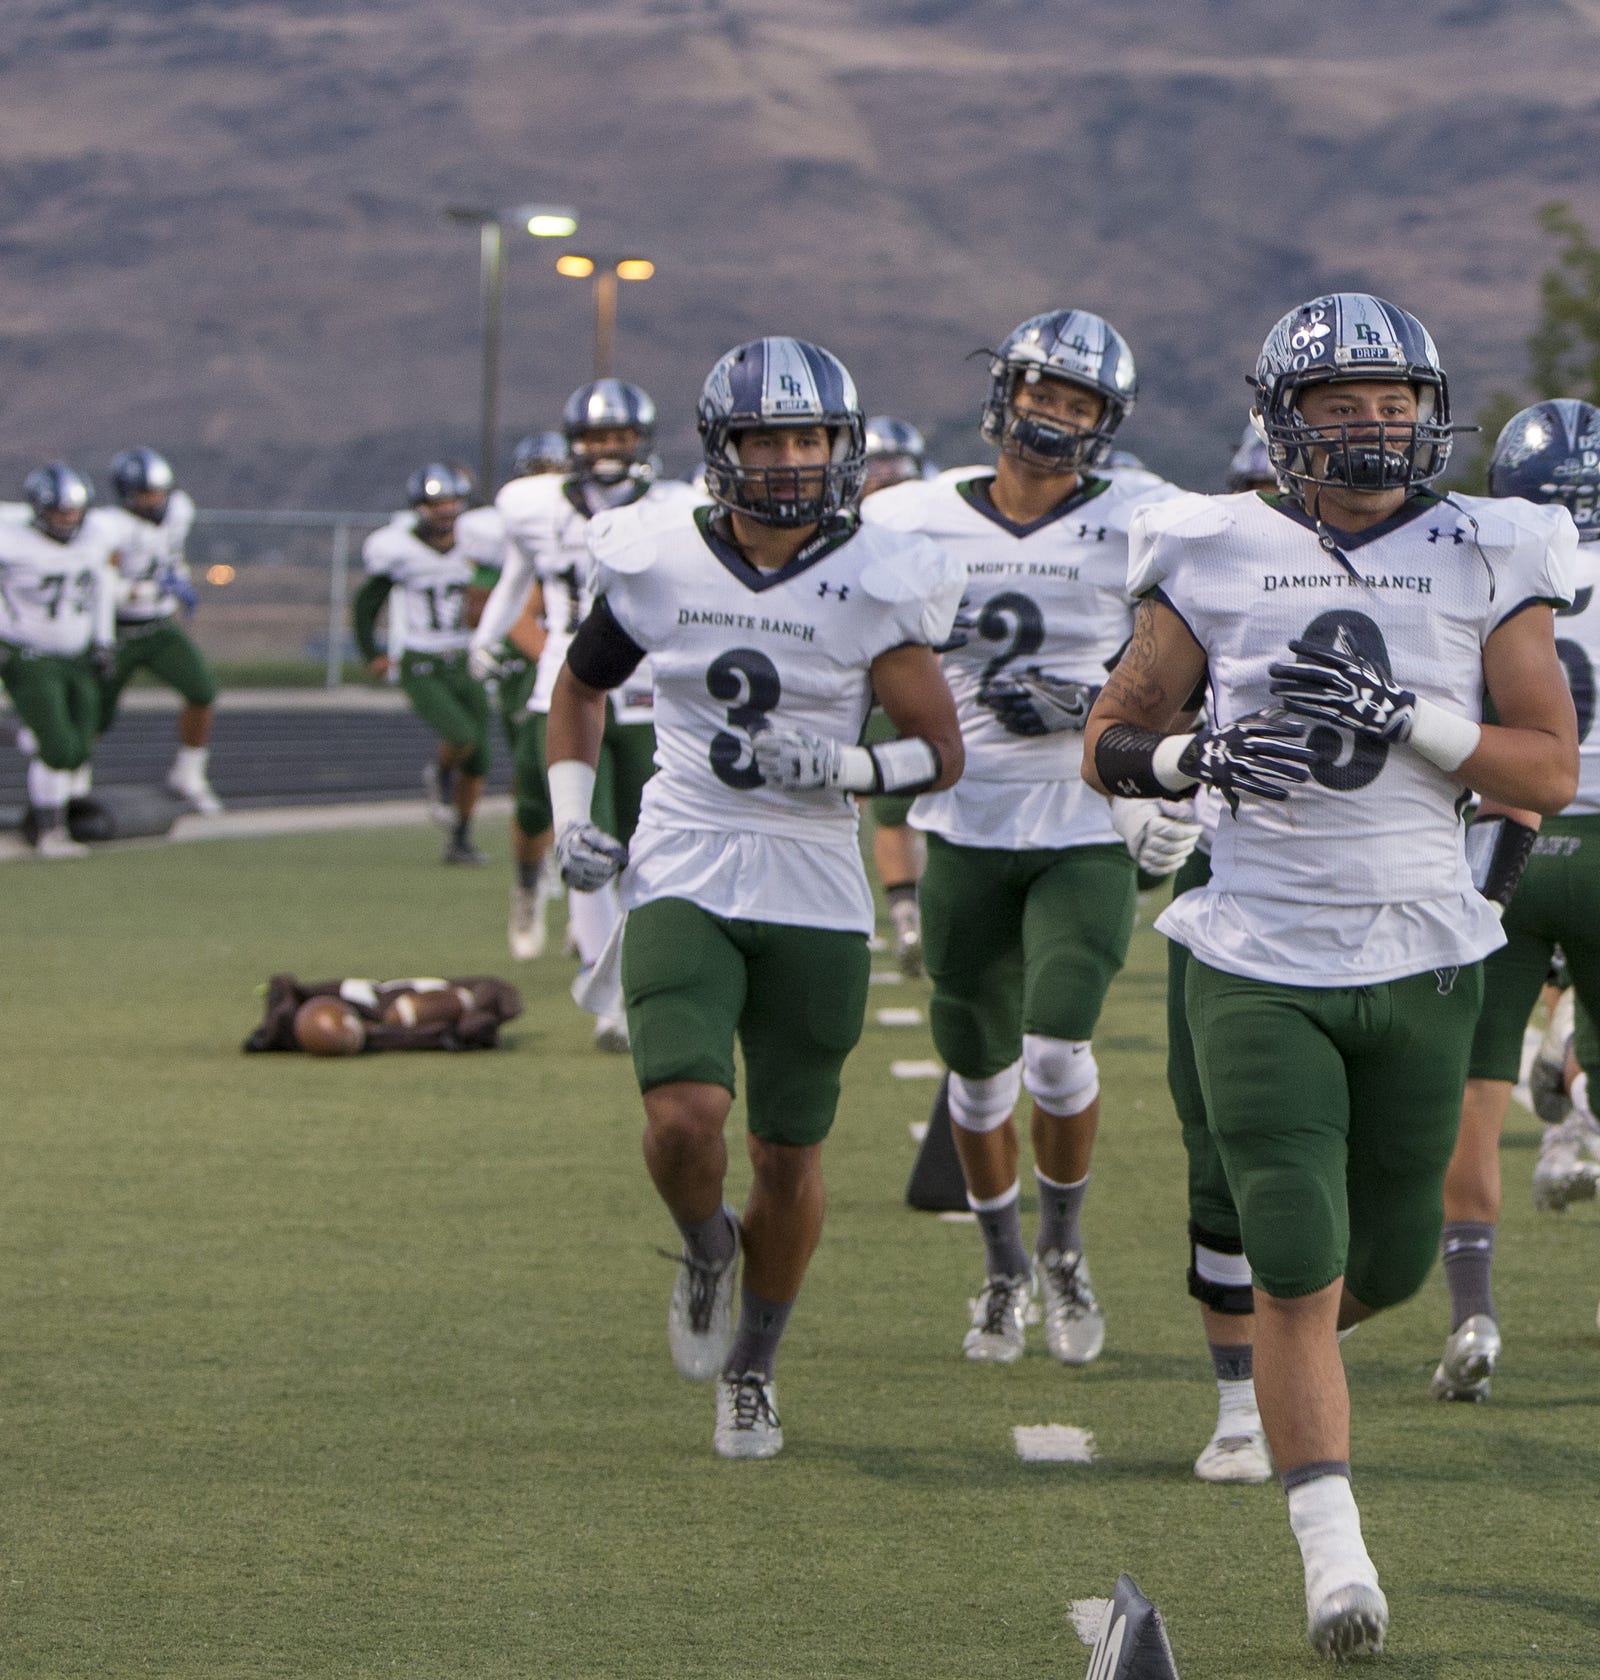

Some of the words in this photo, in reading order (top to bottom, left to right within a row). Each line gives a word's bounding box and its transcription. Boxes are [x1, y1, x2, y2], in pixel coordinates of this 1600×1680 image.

[1355, 323, 1382, 345] DR
[1356, 348, 1384, 358] DRFP
[966, 563, 1024, 574] AMONTE
[1028, 564, 1080, 581] RANCH
[1366, 575, 1432, 594] RANCH
[678, 608, 756, 629] DAMONTE
[760, 617, 816, 642] RANCH
[705, 648, 781, 790] 3
